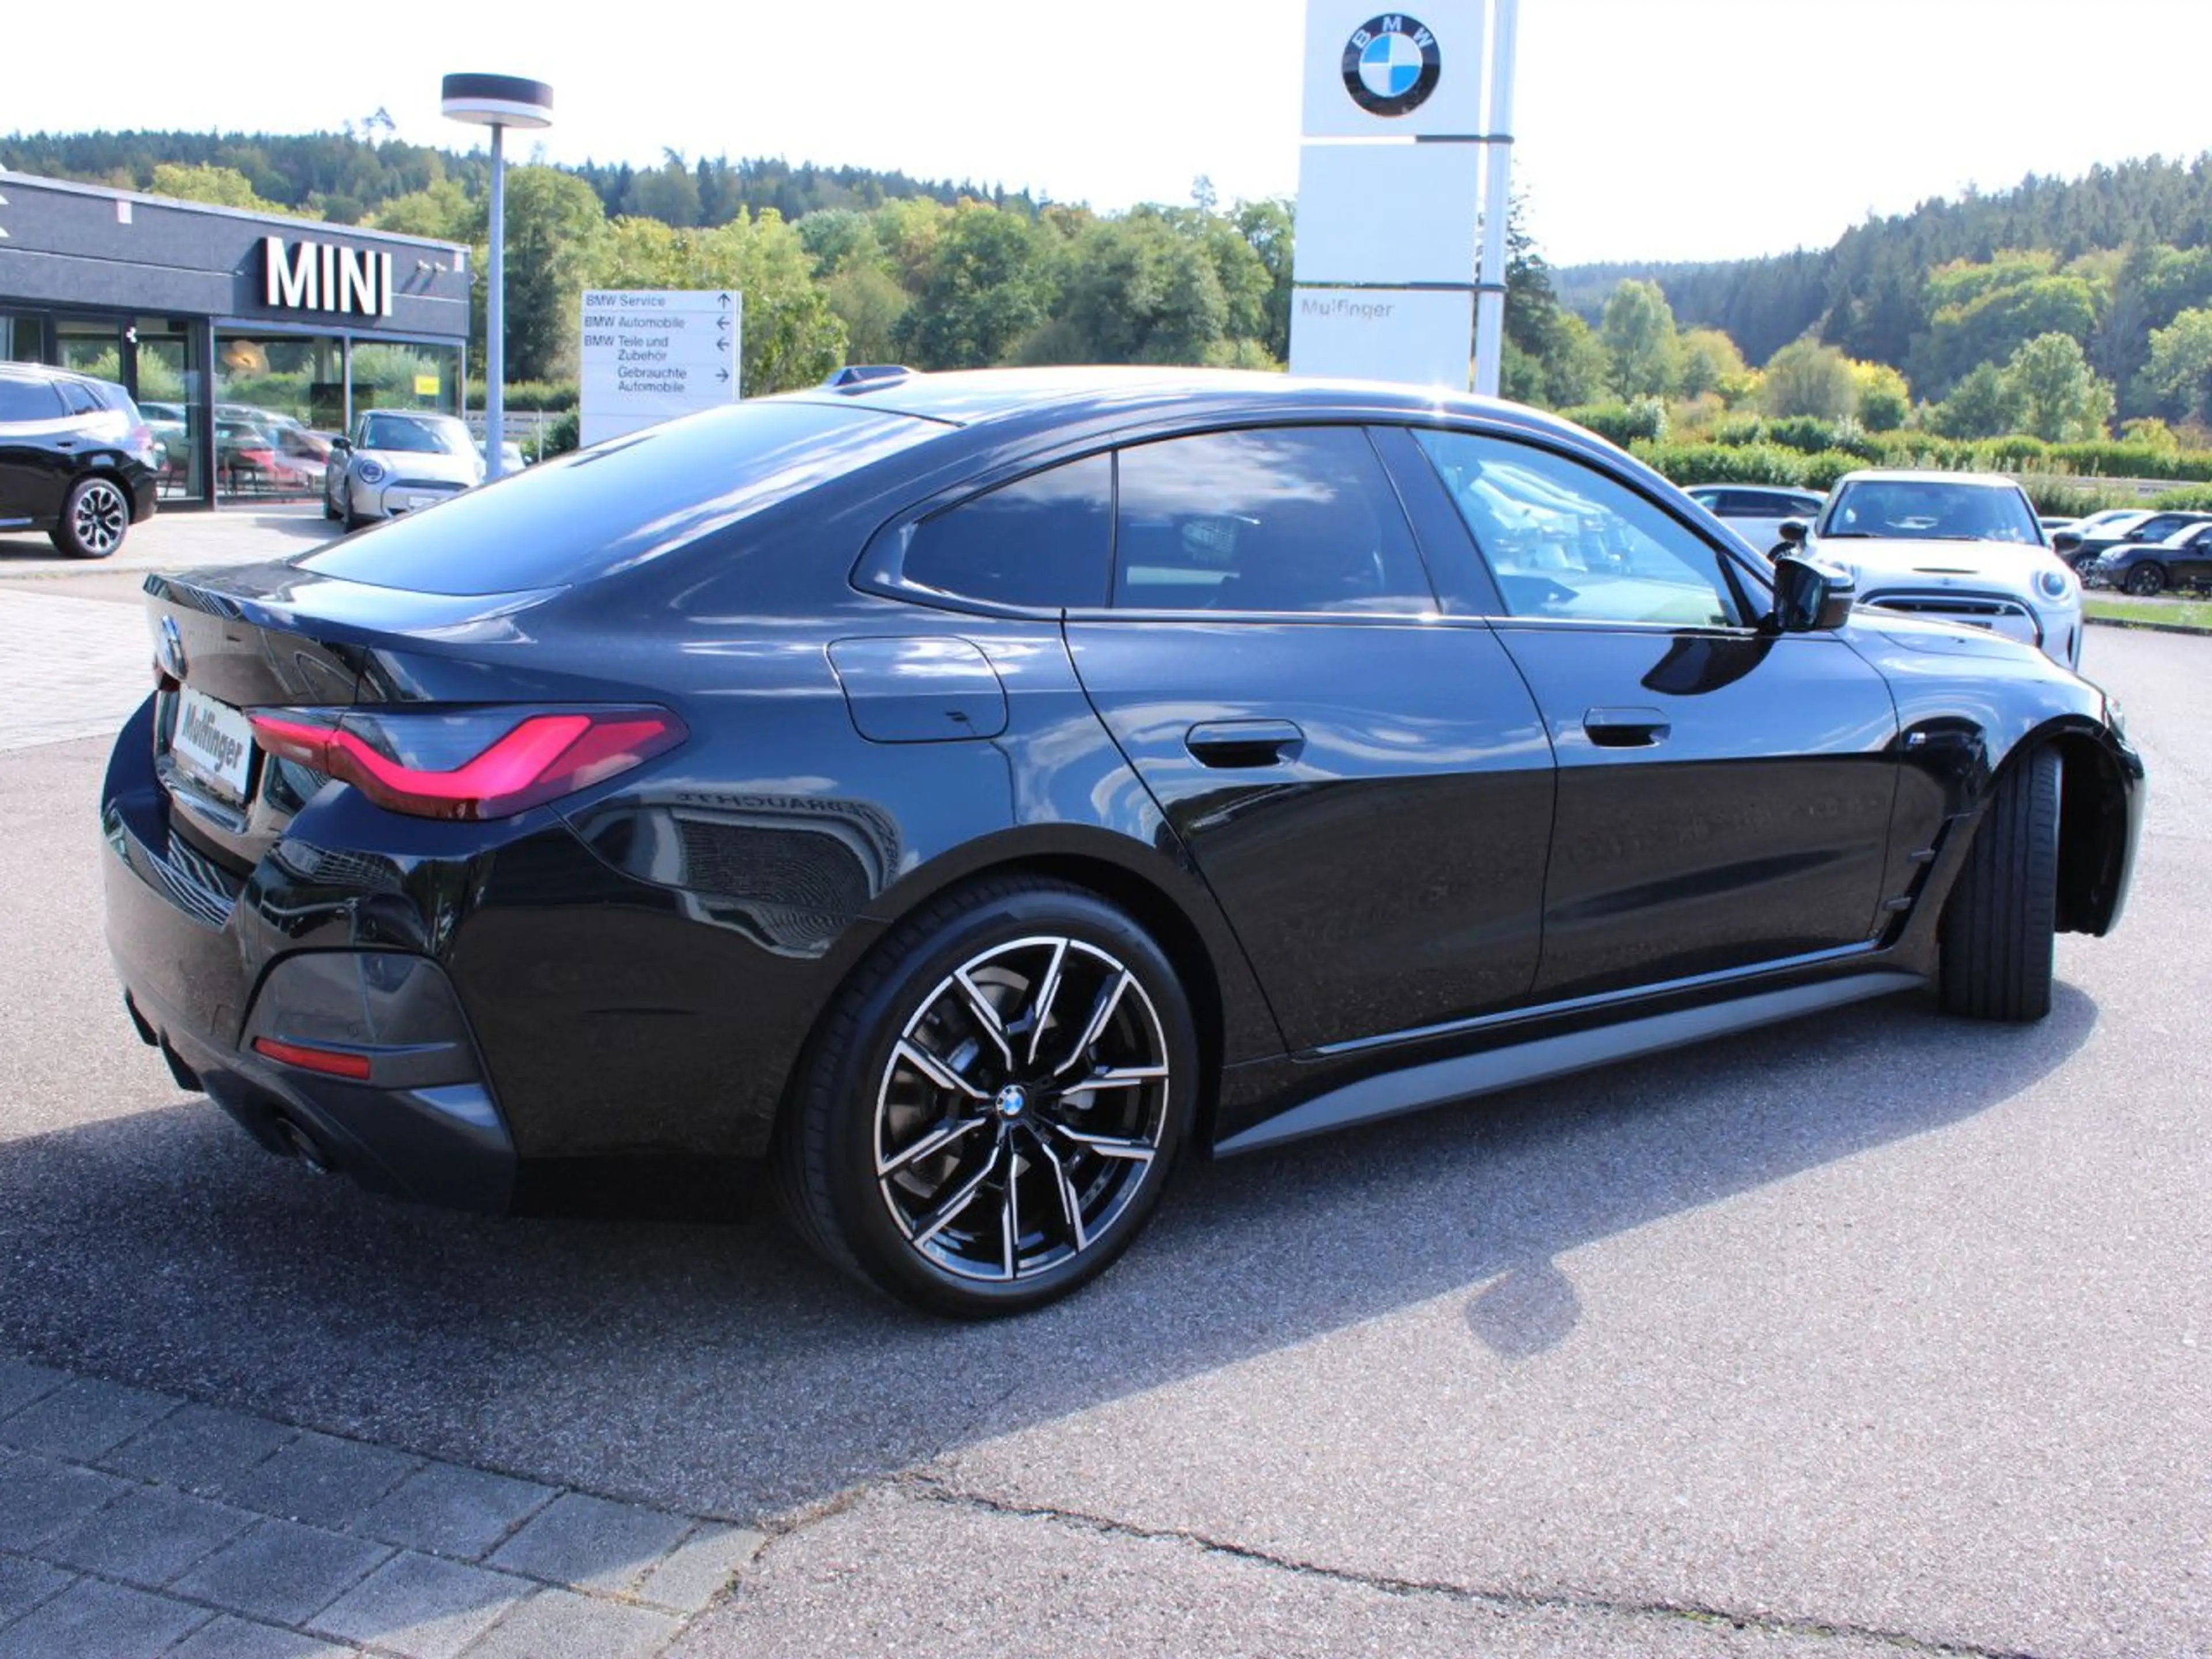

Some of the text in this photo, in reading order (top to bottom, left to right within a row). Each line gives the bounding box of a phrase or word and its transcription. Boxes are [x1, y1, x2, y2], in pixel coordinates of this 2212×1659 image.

[1352, 15, 1434, 49] BMW
[266, 235, 392, 317] MINI
[586, 294, 666, 306] BMW Service
[584, 316, 685, 328] BMW Automobile
[584, 335, 669, 347] BMW Teile und
[618, 366, 687, 380] Gebrauchte
[618, 382, 685, 392] Automobile
